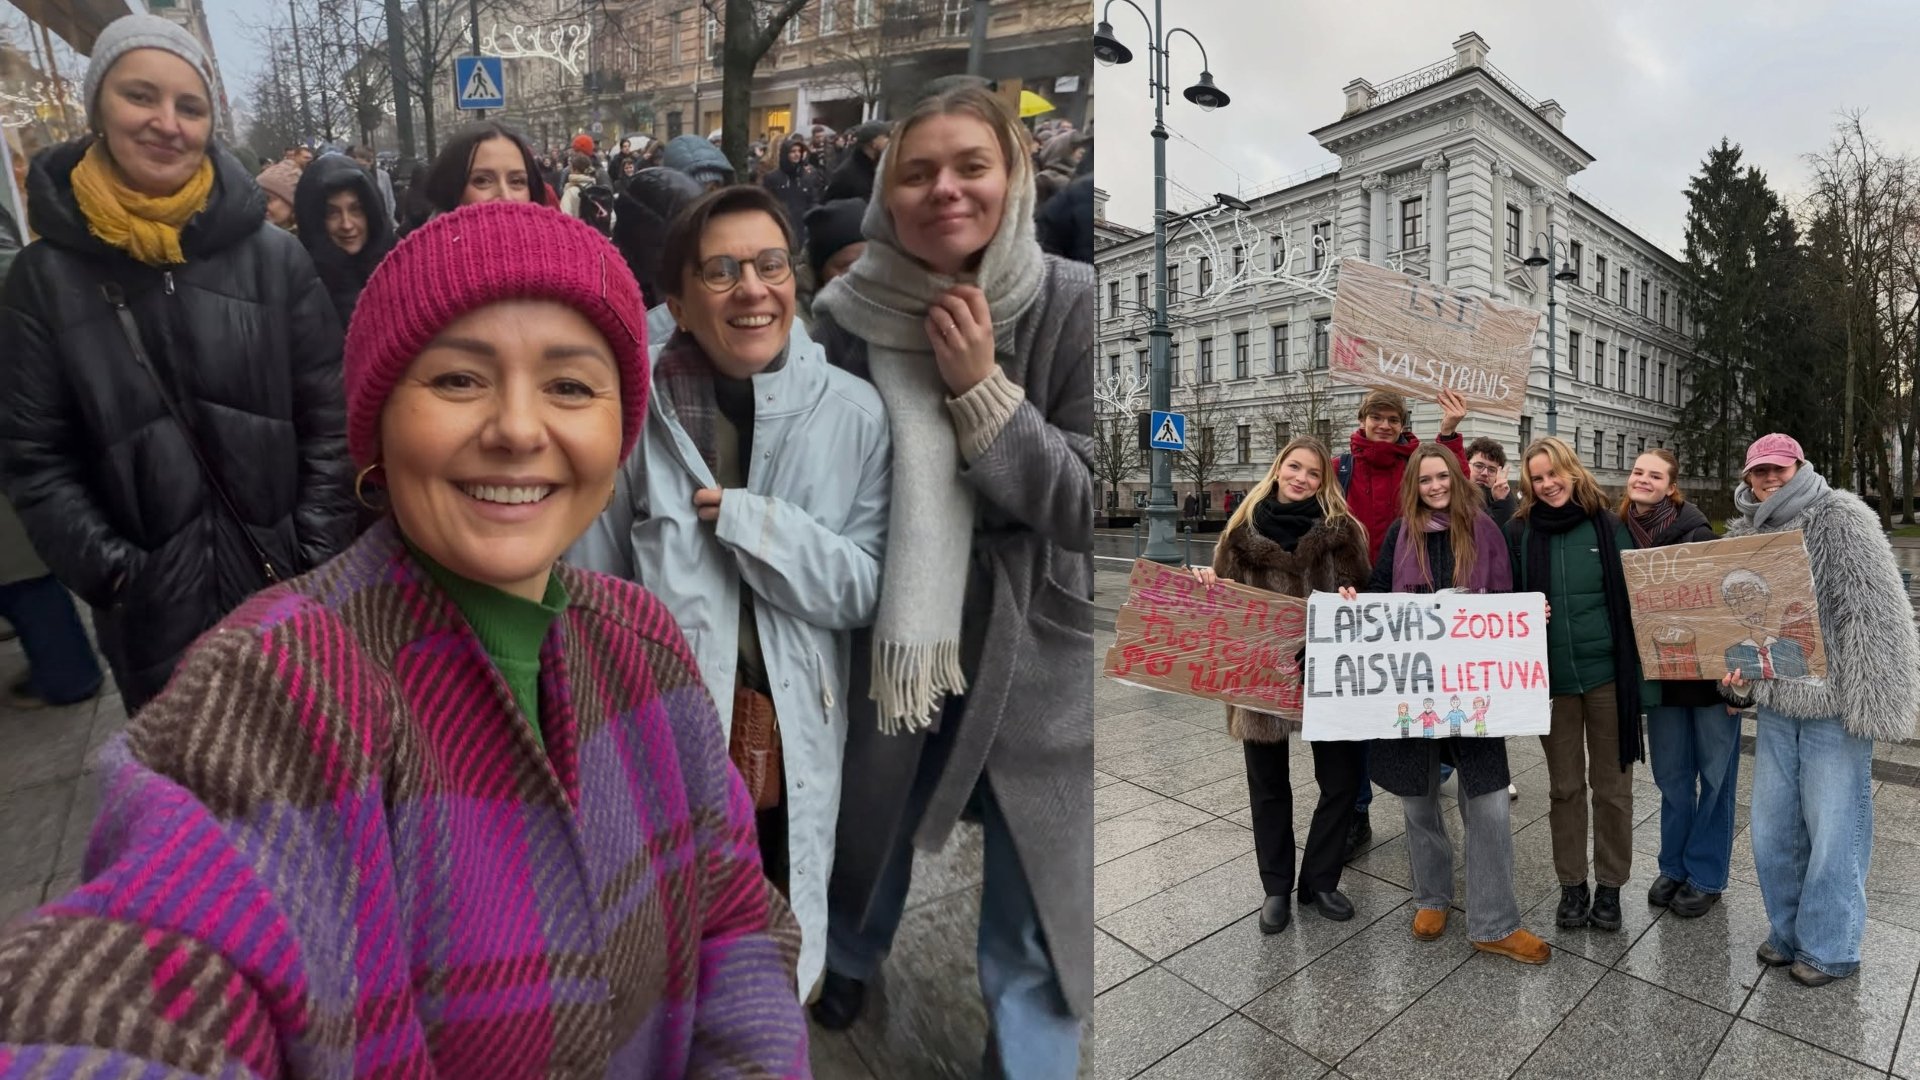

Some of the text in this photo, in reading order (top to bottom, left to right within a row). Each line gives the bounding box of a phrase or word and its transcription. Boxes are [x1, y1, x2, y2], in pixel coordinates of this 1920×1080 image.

[1376, 347, 1510, 400] VALSTYBINIS
[1243, 599, 1305, 637] ne
[1308, 601, 1530, 643] LAISVAS ŽODIS
[1307, 652, 1548, 699] LAISVA LIETUVA
